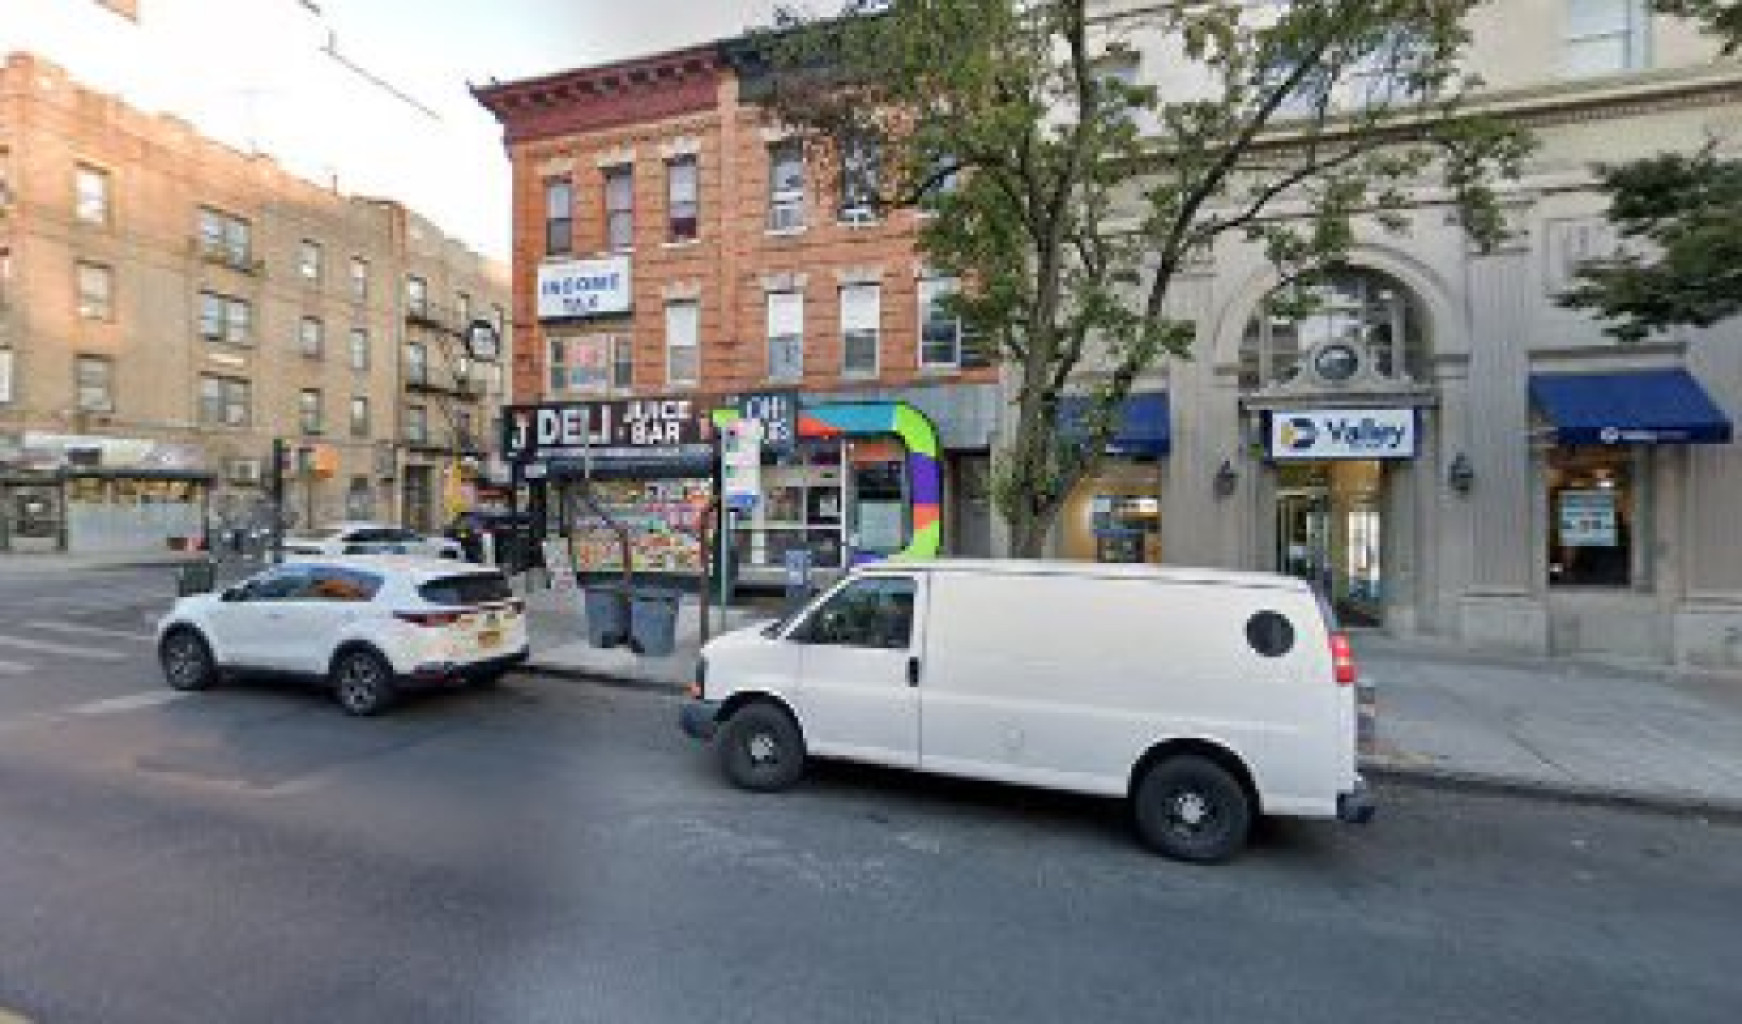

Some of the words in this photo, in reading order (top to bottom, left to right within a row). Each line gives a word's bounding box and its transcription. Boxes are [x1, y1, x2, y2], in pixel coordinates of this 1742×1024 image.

[542, 272, 620, 295] INCOME
[623, 400, 691, 423] JUICE
[537, 404, 611, 444] DELI
[630, 421, 680, 445] BAR
[1323, 417, 1406, 449] Valley
